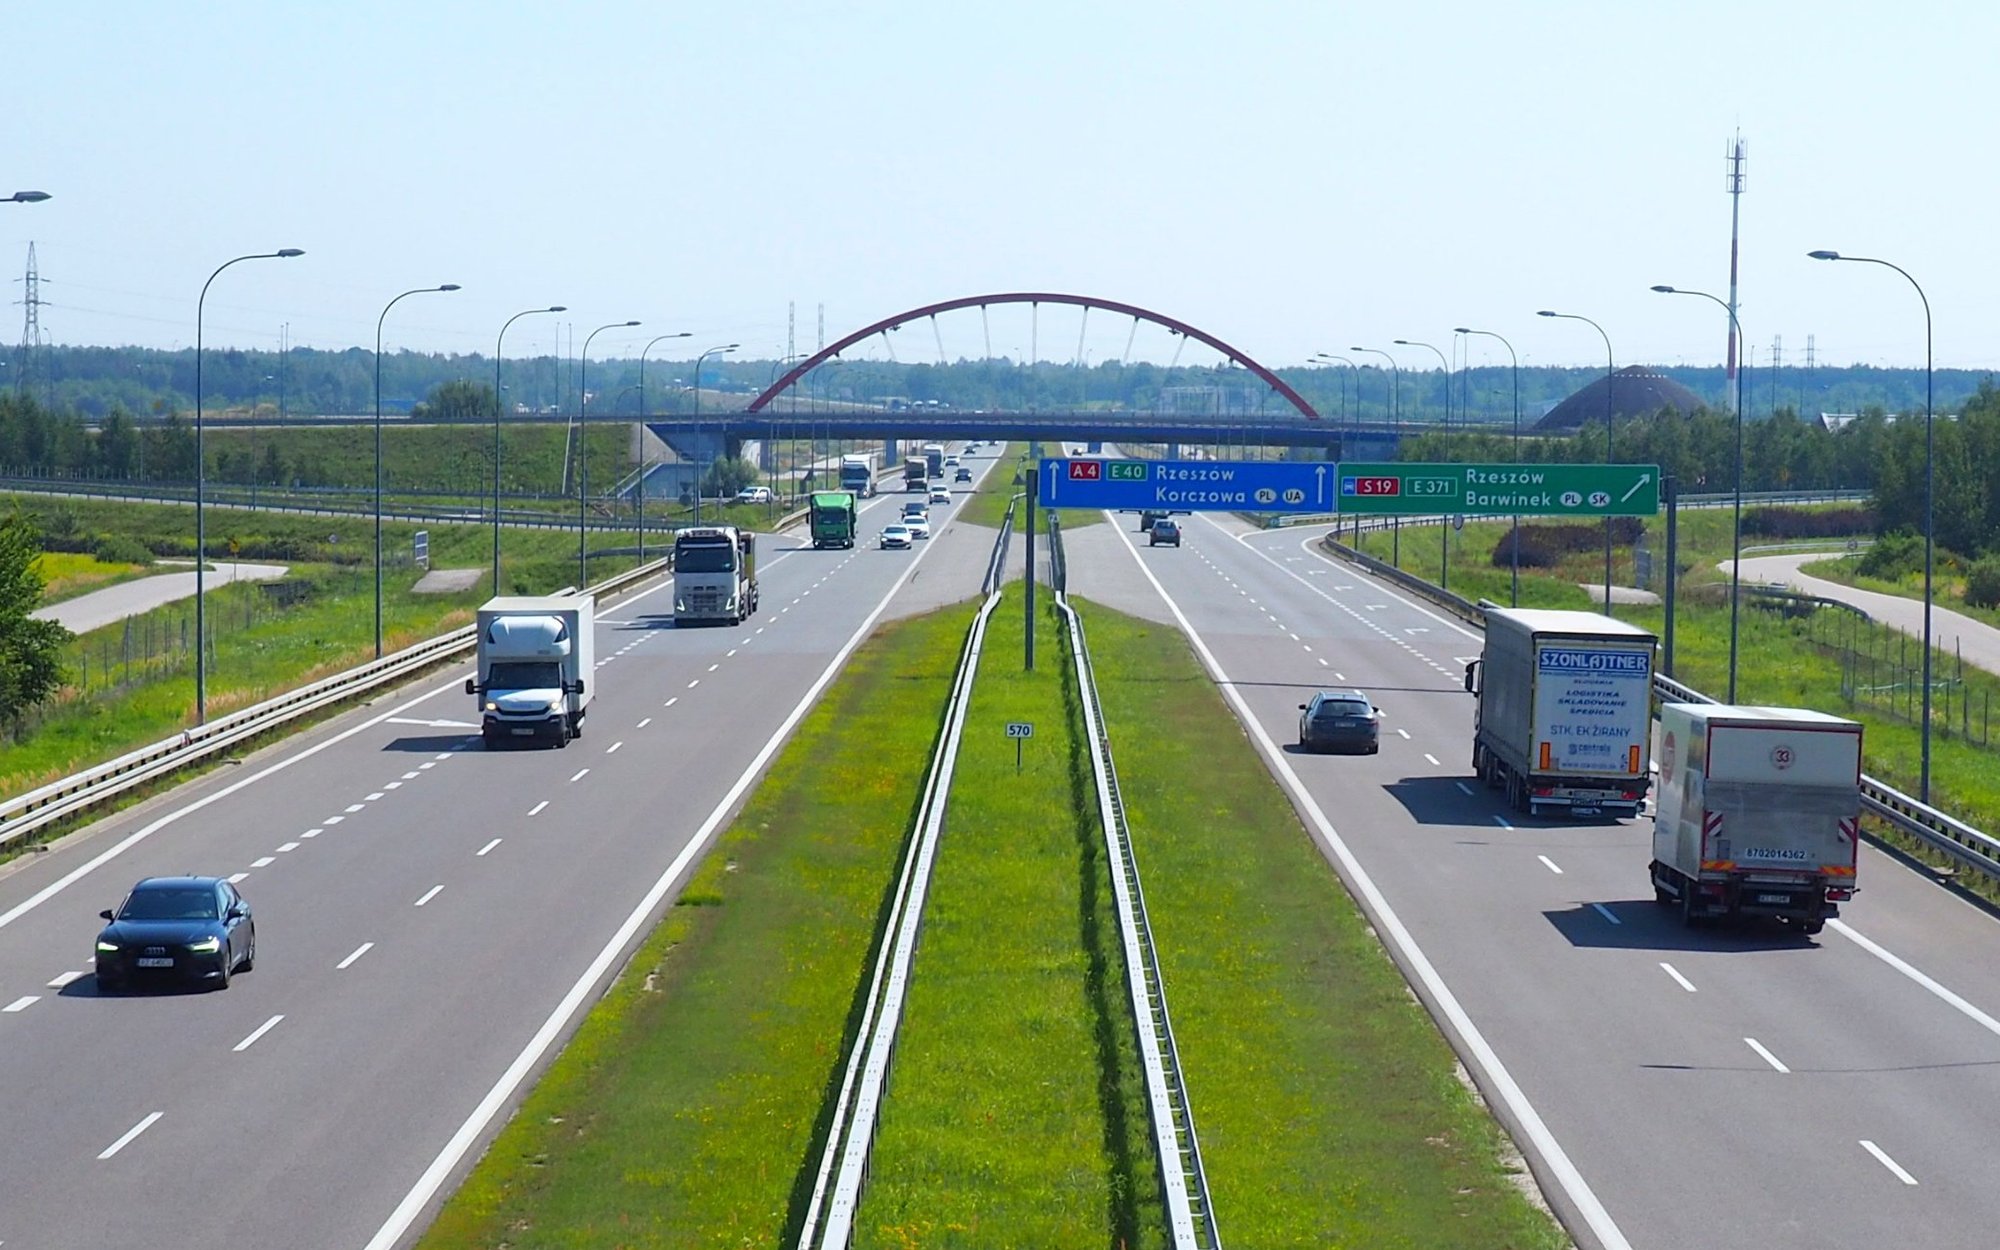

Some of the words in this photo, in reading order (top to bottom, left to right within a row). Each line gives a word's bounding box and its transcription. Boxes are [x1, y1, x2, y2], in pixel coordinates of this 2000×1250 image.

[1073, 464, 1083, 477] A
[1087, 464, 1097, 478] 4
[1111, 465, 1119, 478] E
[1123, 465, 1142, 478] 40
[1156, 464, 1235, 481] Rzeszów
[1466, 468, 1545, 484] Rzeszów
[1363, 480, 1372, 493] S
[1376, 480, 1392, 493] 19
[1414, 480, 1422, 493] E
[1426, 480, 1449, 493] 371
[1155, 486, 1246, 503] Korczowa
[1259, 490, 1272, 501] PL
[1285, 491, 1301, 501] UA
[1466, 490, 1551, 507] Barwinek
[1564, 493, 1577, 504] PL
[1592, 494, 1607, 505] SK
[1541, 652, 1648, 672] SZONLAJTNER
[1566, 690, 1620, 698] LOGISTIKA
[1557, 698, 1628, 708] SKLADOVANIE
[1008, 725, 1030, 736] 570
[1576, 726, 1590, 736] EK
